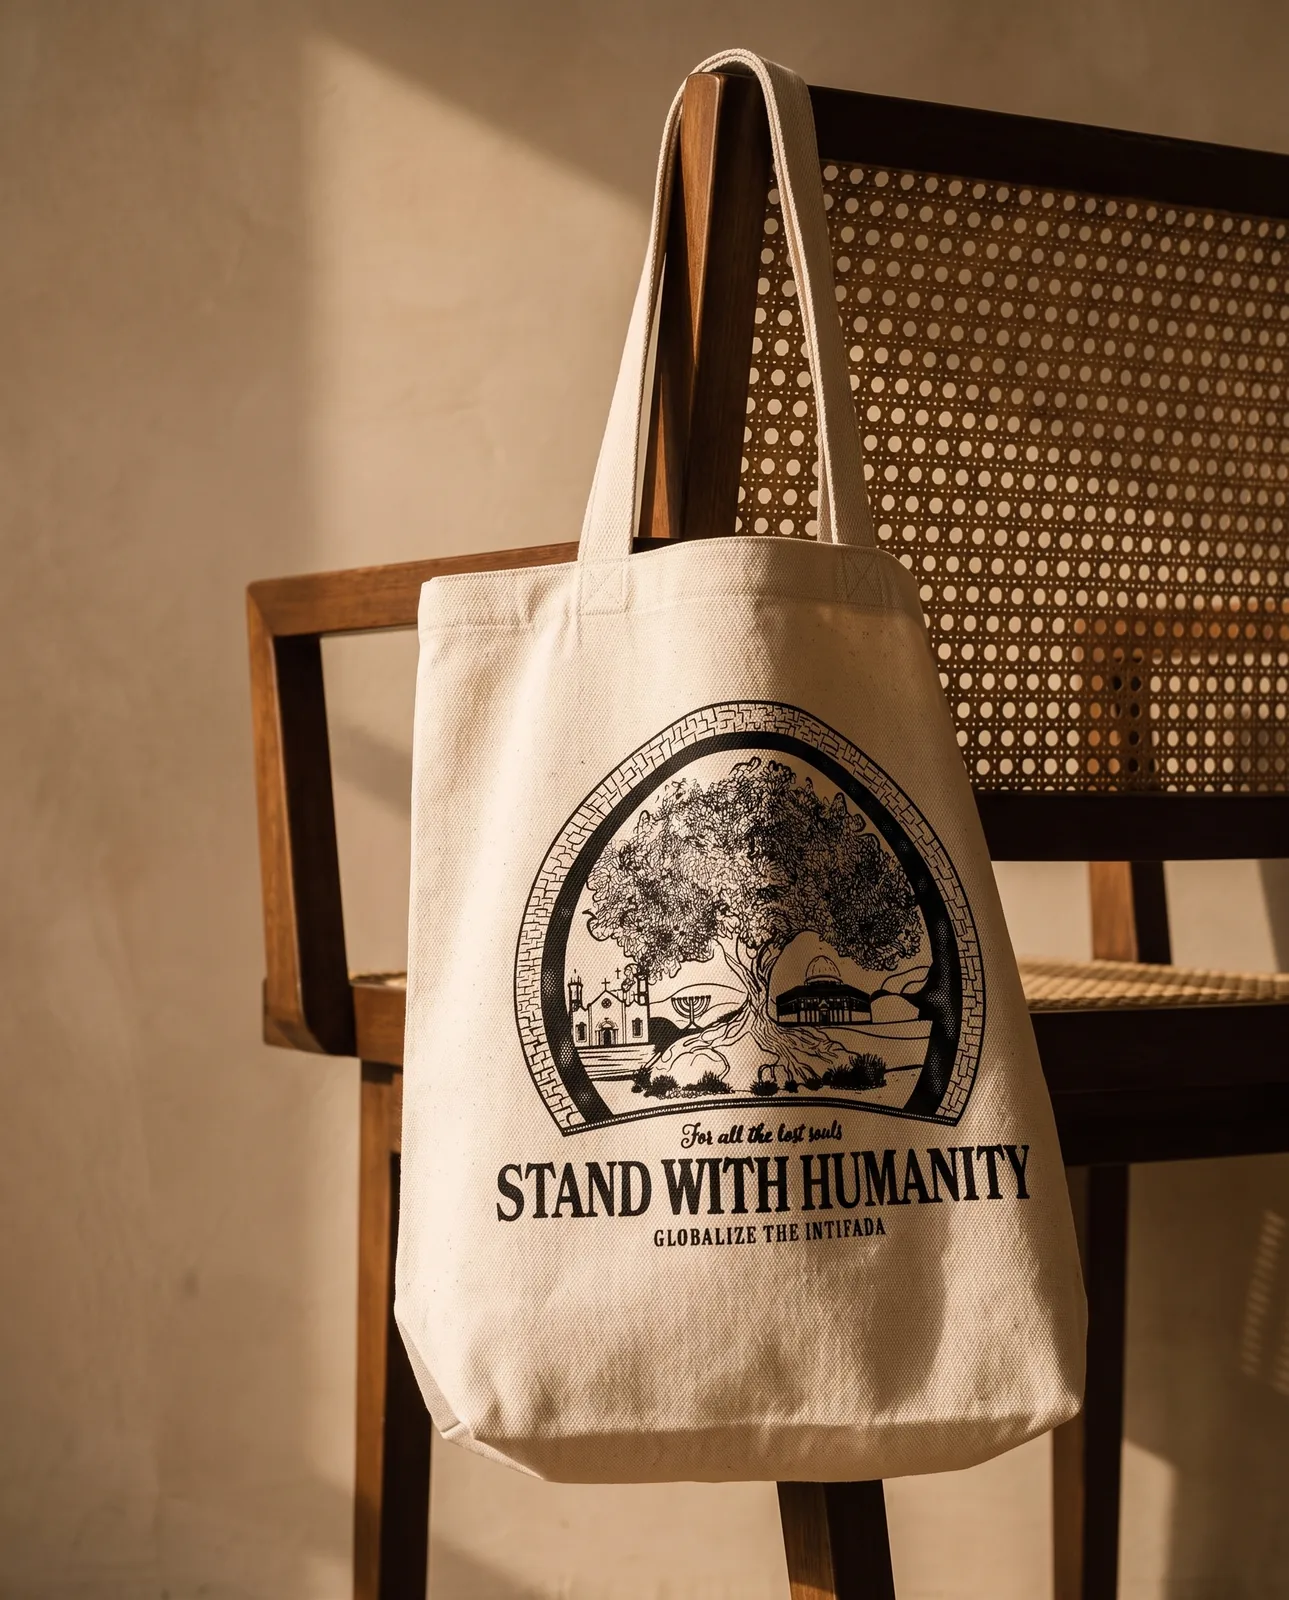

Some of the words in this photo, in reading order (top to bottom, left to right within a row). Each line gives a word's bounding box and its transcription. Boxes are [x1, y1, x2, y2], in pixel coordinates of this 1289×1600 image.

[680, 1121, 714, 1149] For
[717, 1124, 744, 1145] all
[747, 1122, 774, 1144] the
[776, 1122, 807, 1145] lost
[808, 1119, 843, 1143] souls
[496, 1160, 652, 1222] STAND
[660, 1155, 791, 1216] WITH
[799, 1143, 1031, 1212] HUMANITY
[653, 1225, 757, 1248] GLOBALIZE
[762, 1222, 800, 1244] THE
[804, 1216, 887, 1242] INTIFADA
